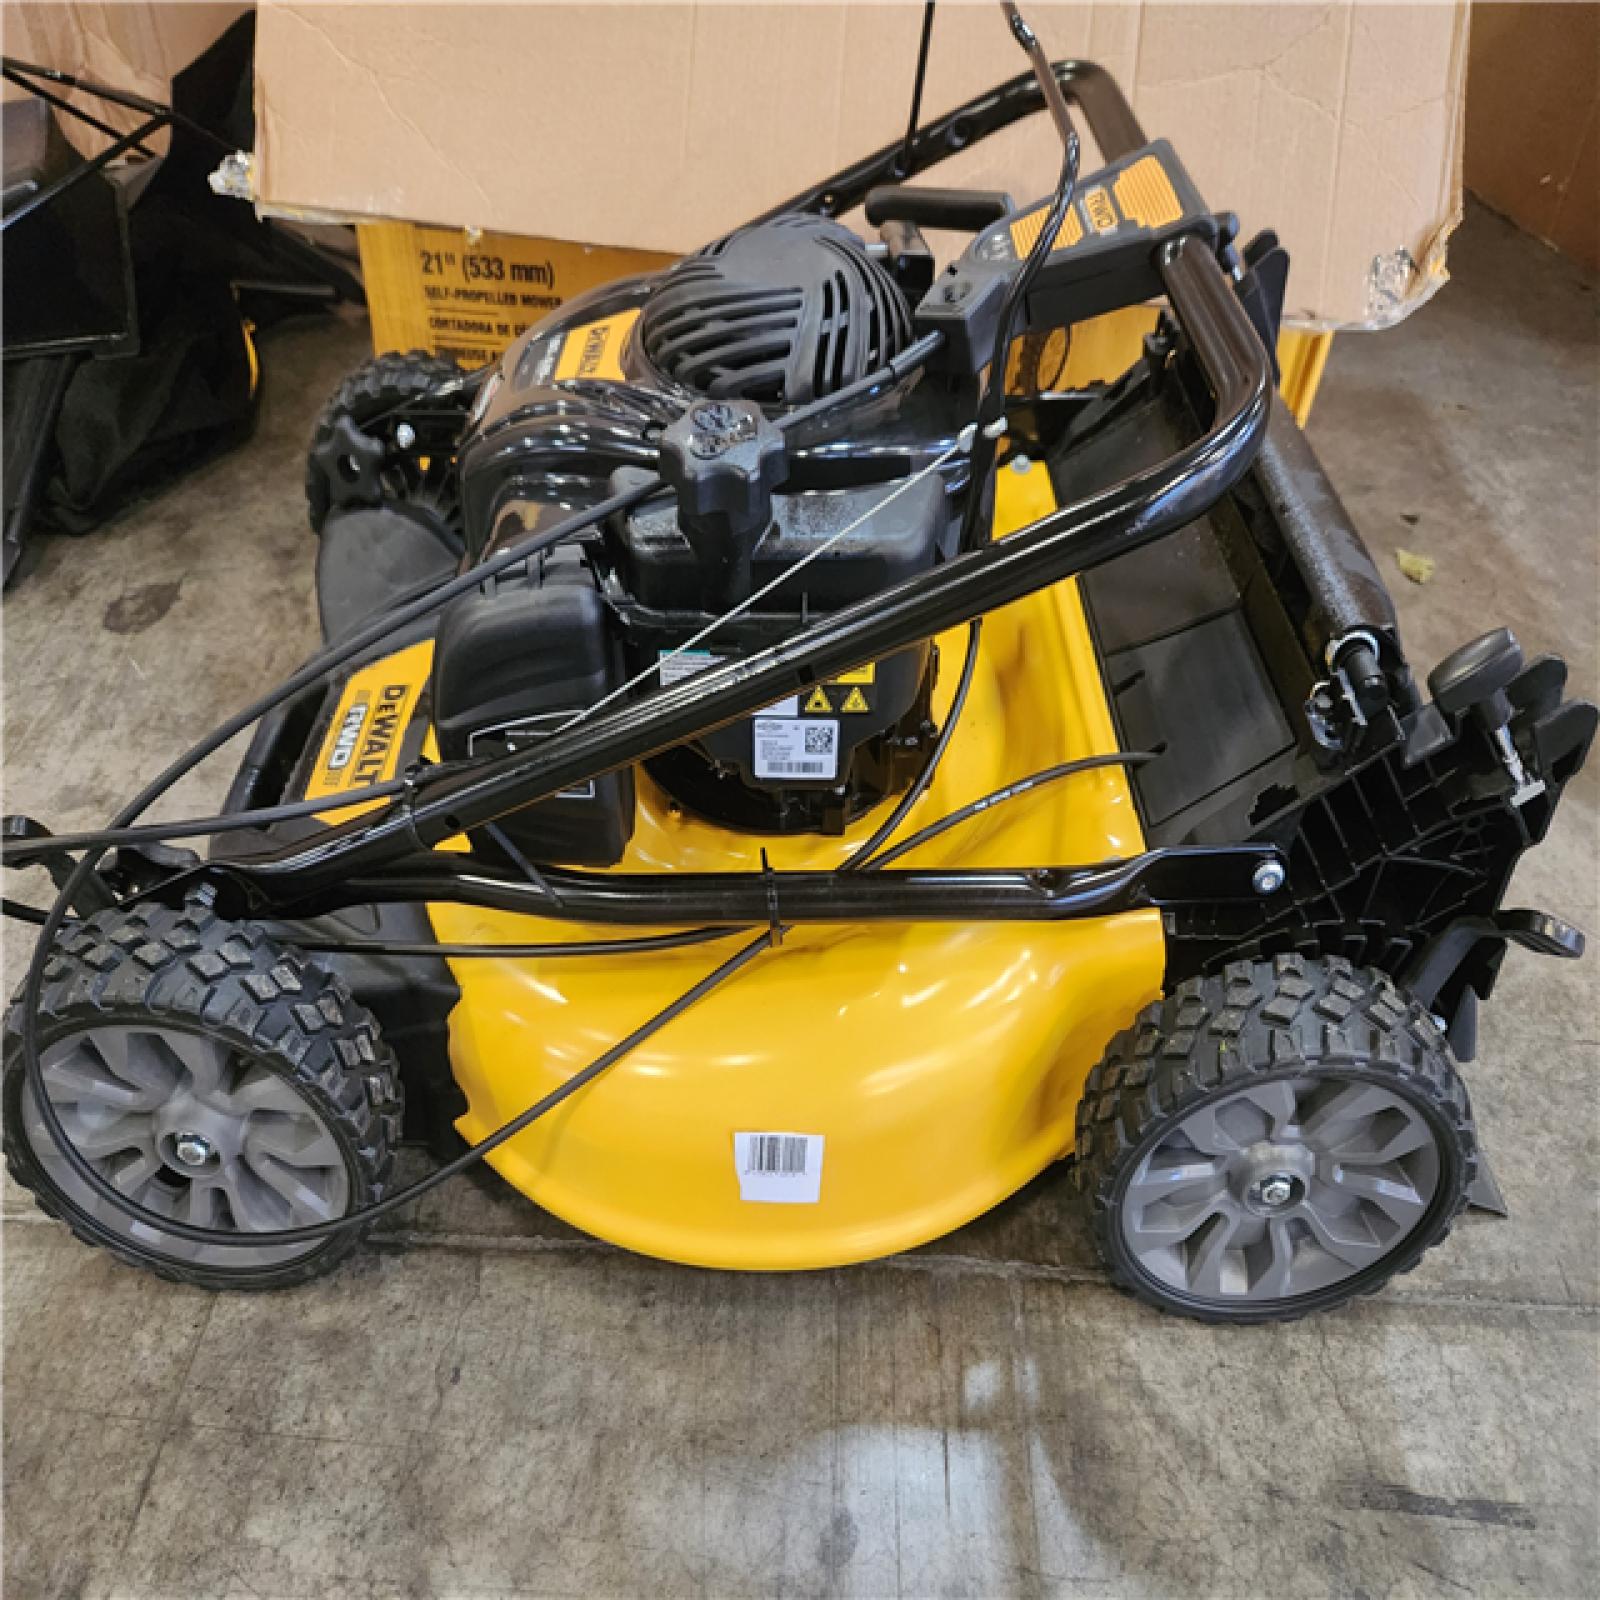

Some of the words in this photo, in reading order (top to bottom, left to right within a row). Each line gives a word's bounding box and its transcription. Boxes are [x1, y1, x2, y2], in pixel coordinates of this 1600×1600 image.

[463, 254, 505, 282] (533
[510, 259, 555, 290] mm)
[429, 317, 493, 333] CORTADORA
[496, 324, 510, 336] DE
